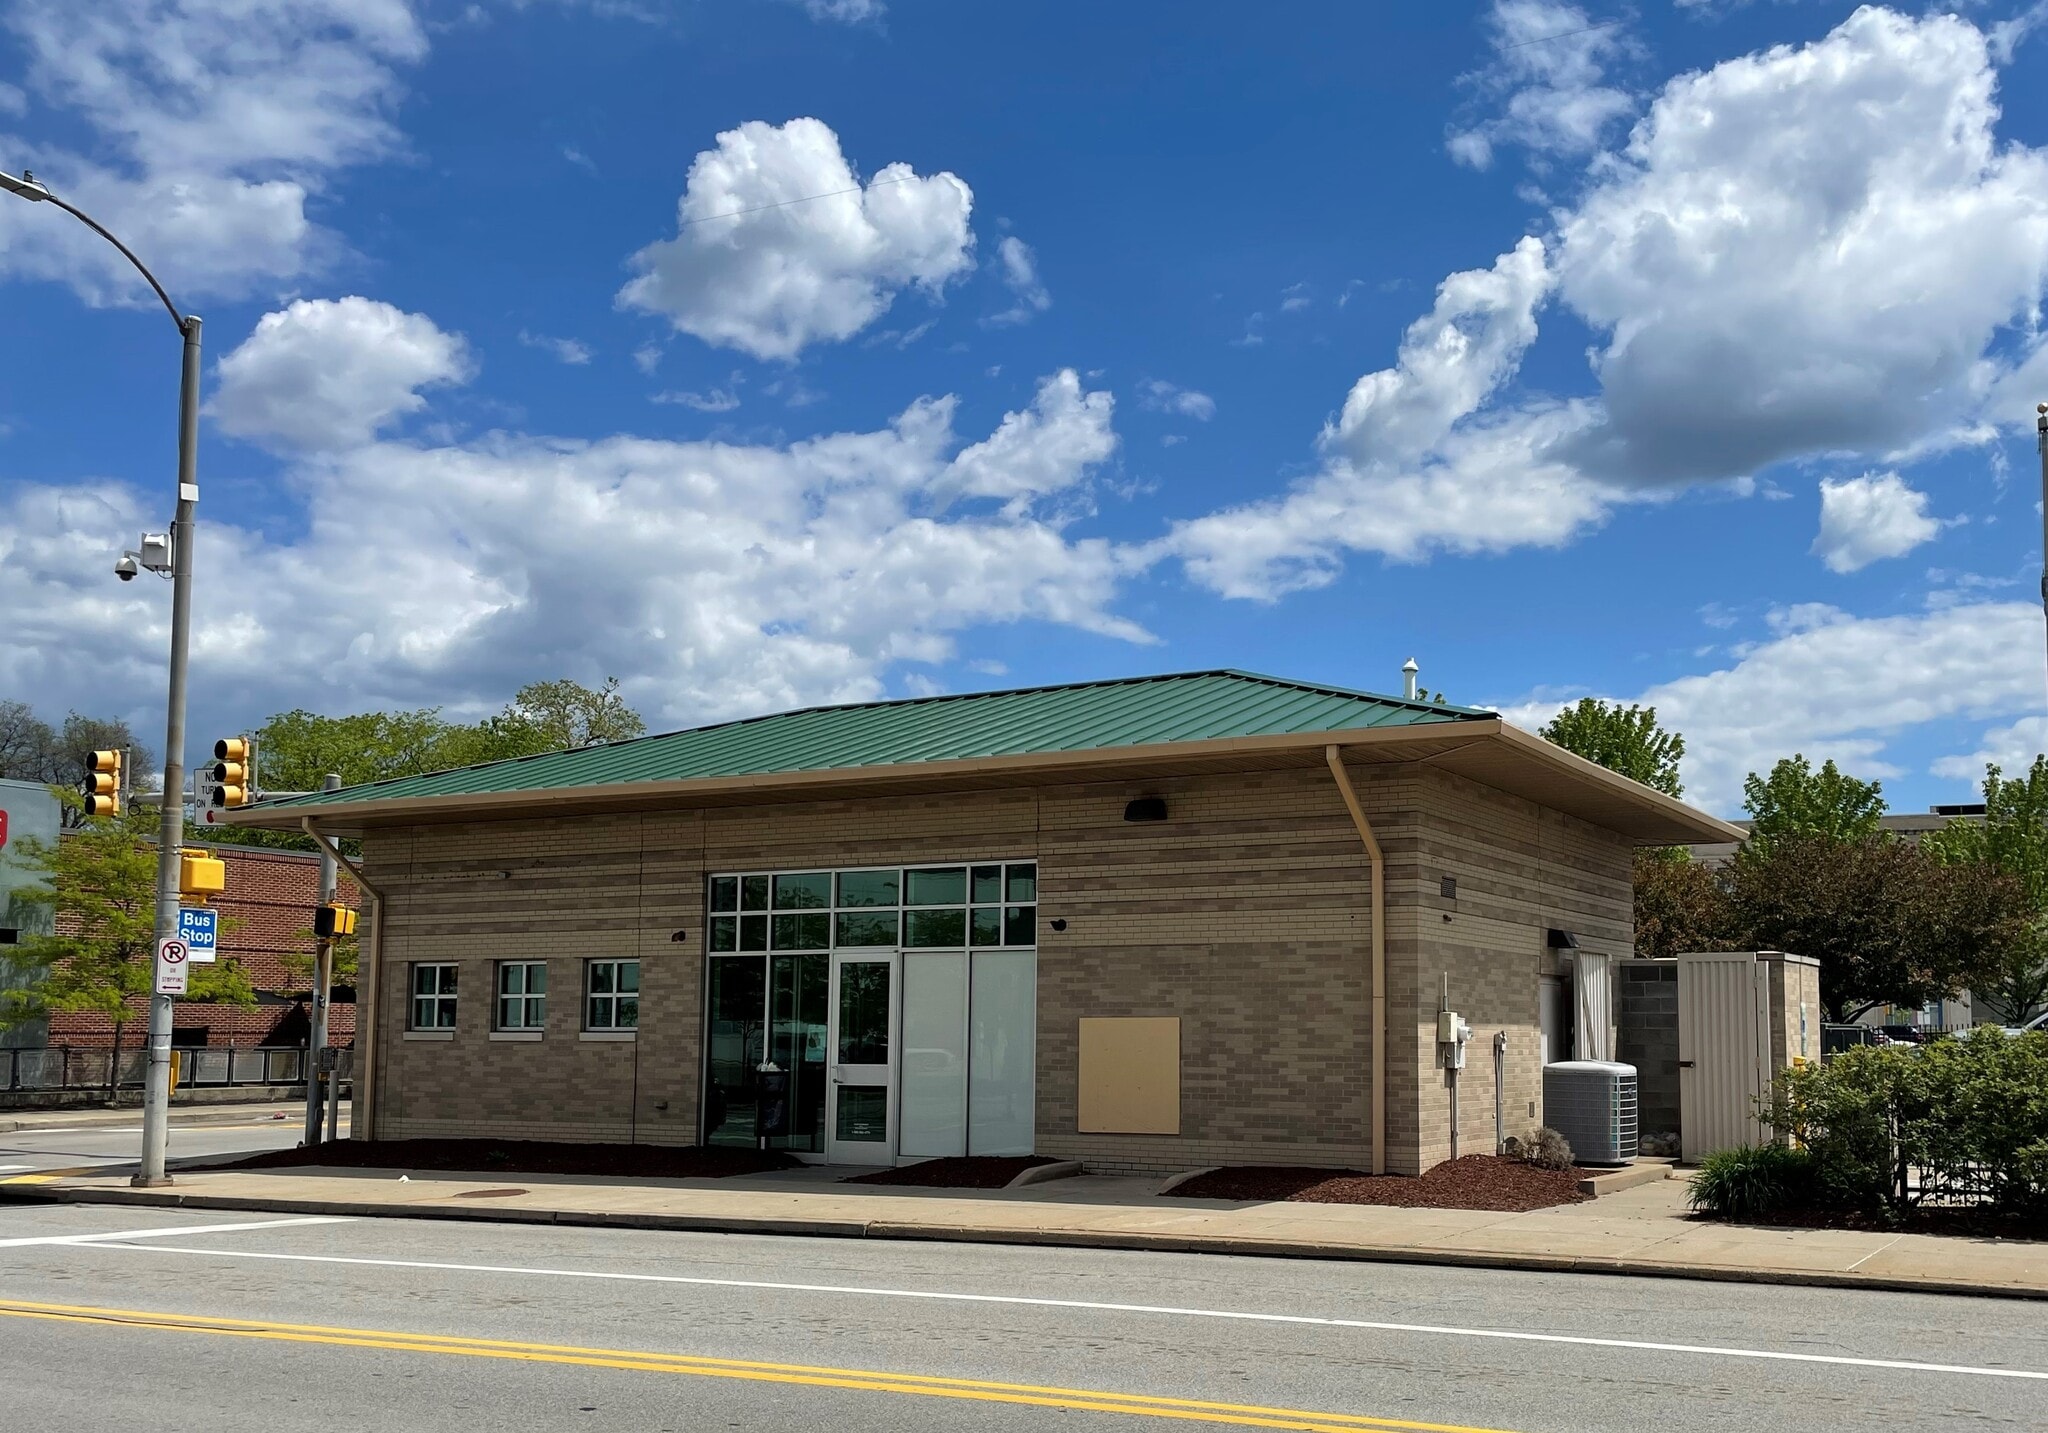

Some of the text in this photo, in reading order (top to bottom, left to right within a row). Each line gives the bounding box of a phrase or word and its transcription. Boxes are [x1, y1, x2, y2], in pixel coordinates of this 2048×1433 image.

[205, 771, 215, 782] NO
[196, 799, 206, 808] ON
[184, 912, 210, 926] Bus
[180, 928, 212, 944] Stop
